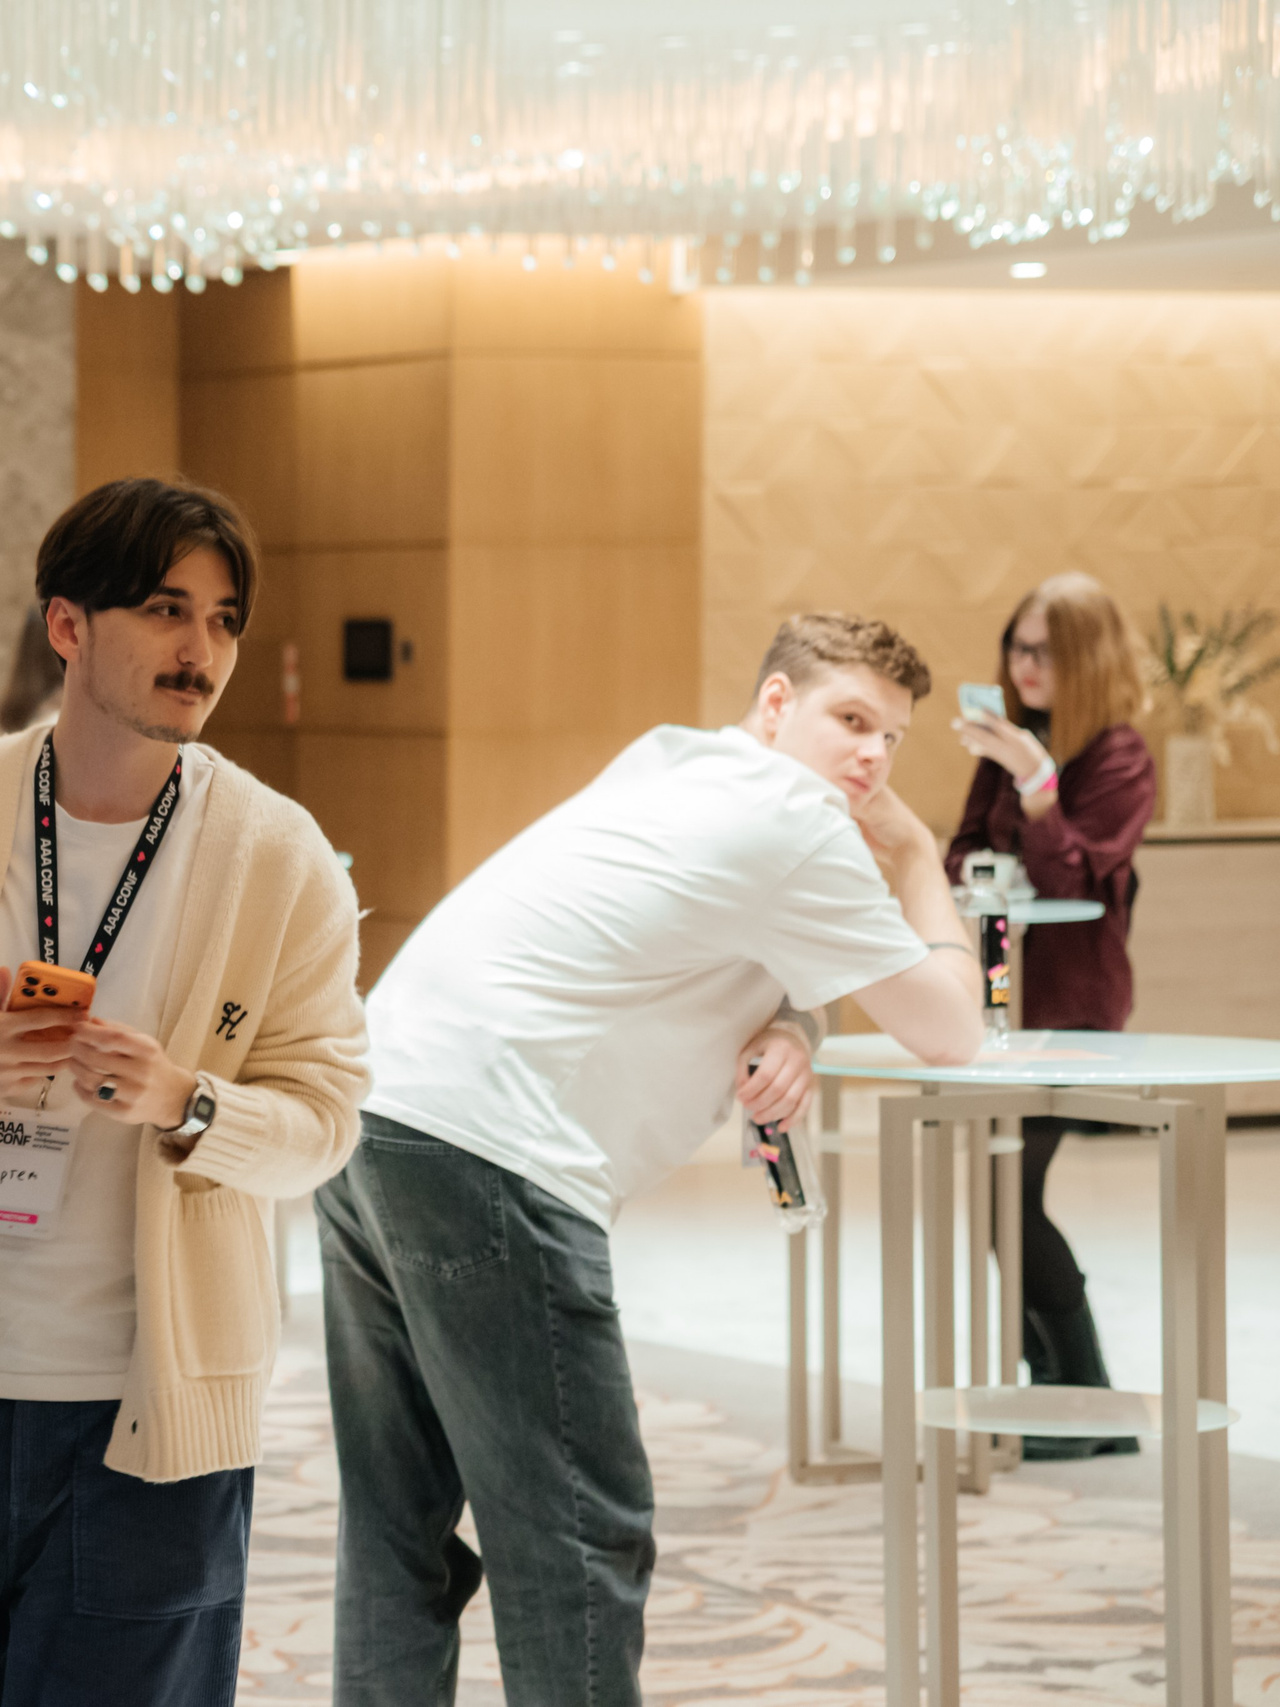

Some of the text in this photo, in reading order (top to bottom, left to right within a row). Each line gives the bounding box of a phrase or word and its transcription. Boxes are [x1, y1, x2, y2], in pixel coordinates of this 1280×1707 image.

[38, 743, 51, 807] AAA CONF
[145, 781, 177, 846] AAA CONF
[40, 837, 54, 907] AAA CONF
[103, 869, 139, 937] AAA CONF
